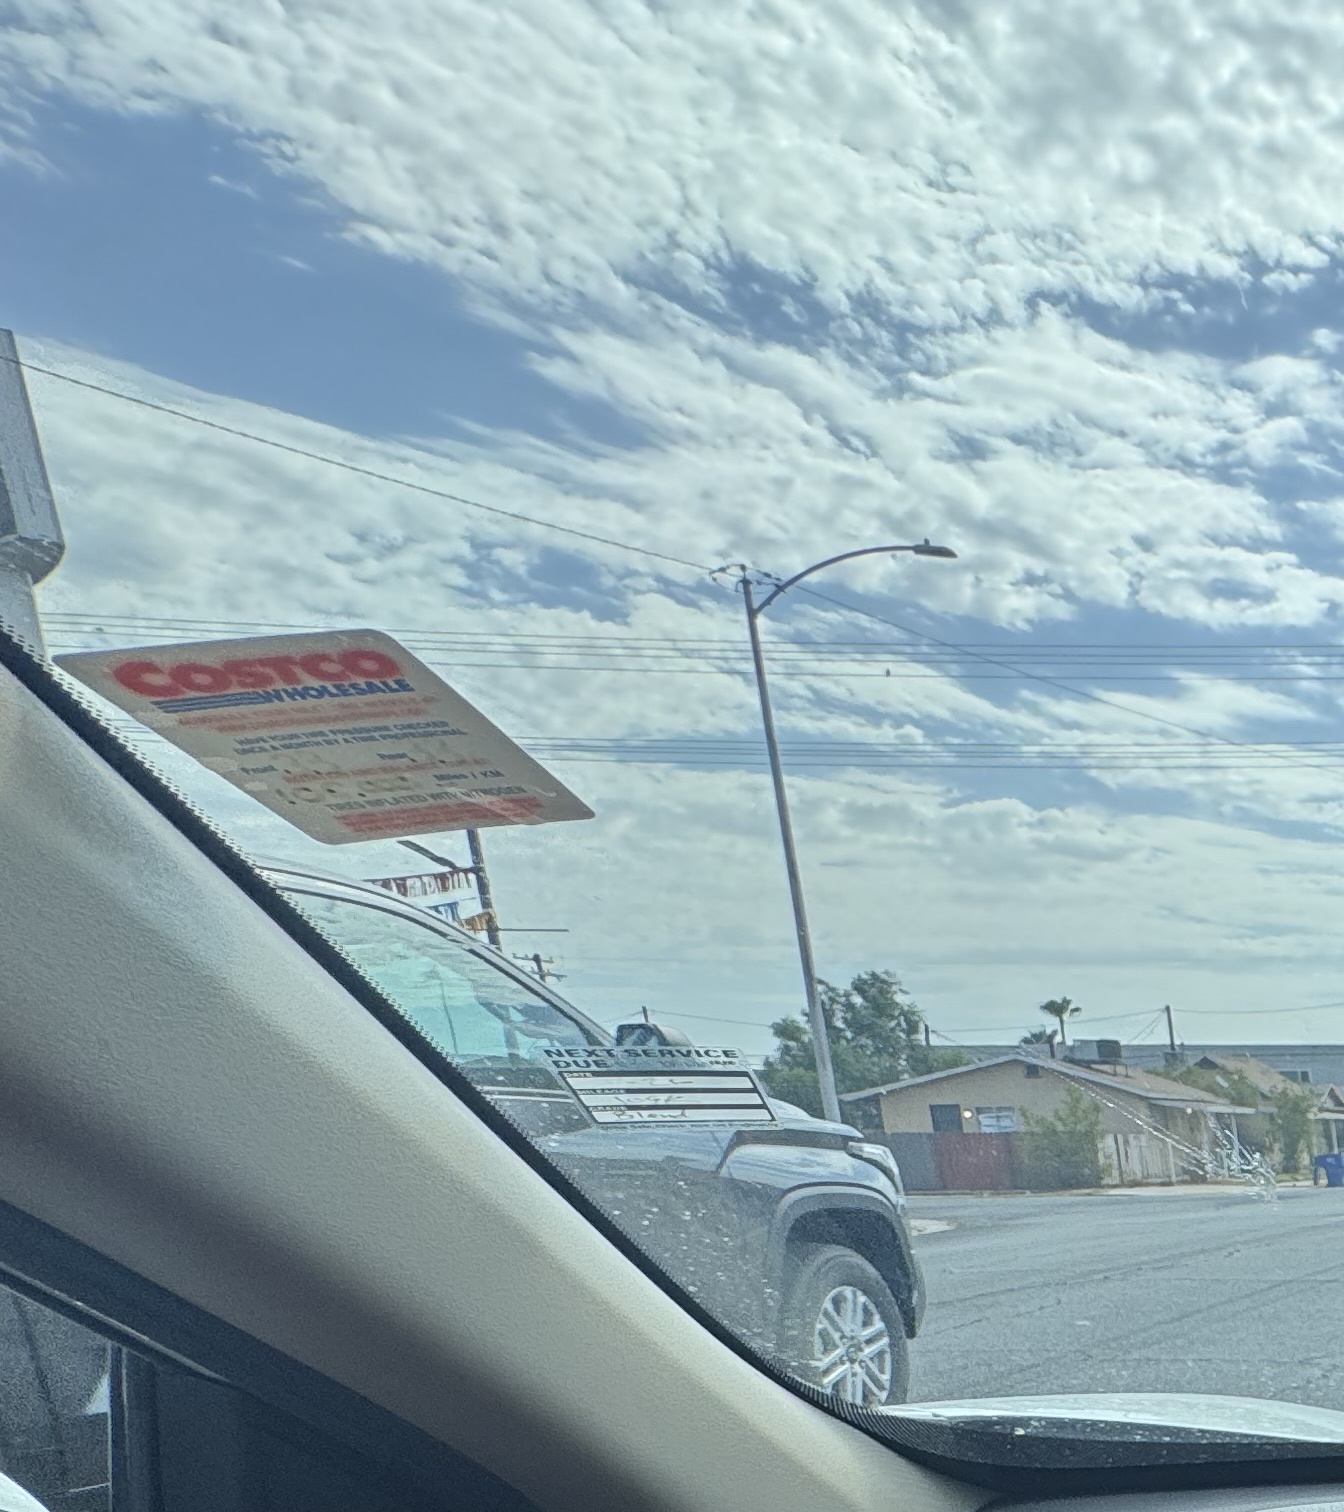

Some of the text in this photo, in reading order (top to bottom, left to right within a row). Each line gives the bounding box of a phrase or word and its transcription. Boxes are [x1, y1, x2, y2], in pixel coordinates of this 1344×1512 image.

[112, 649, 402, 697] COSTCO
[259, 679, 415, 704] WHOLESALE
[543, 1048, 739, 1059] NEXT SERVICE
[553, 1059, 612, 1069] DUE
